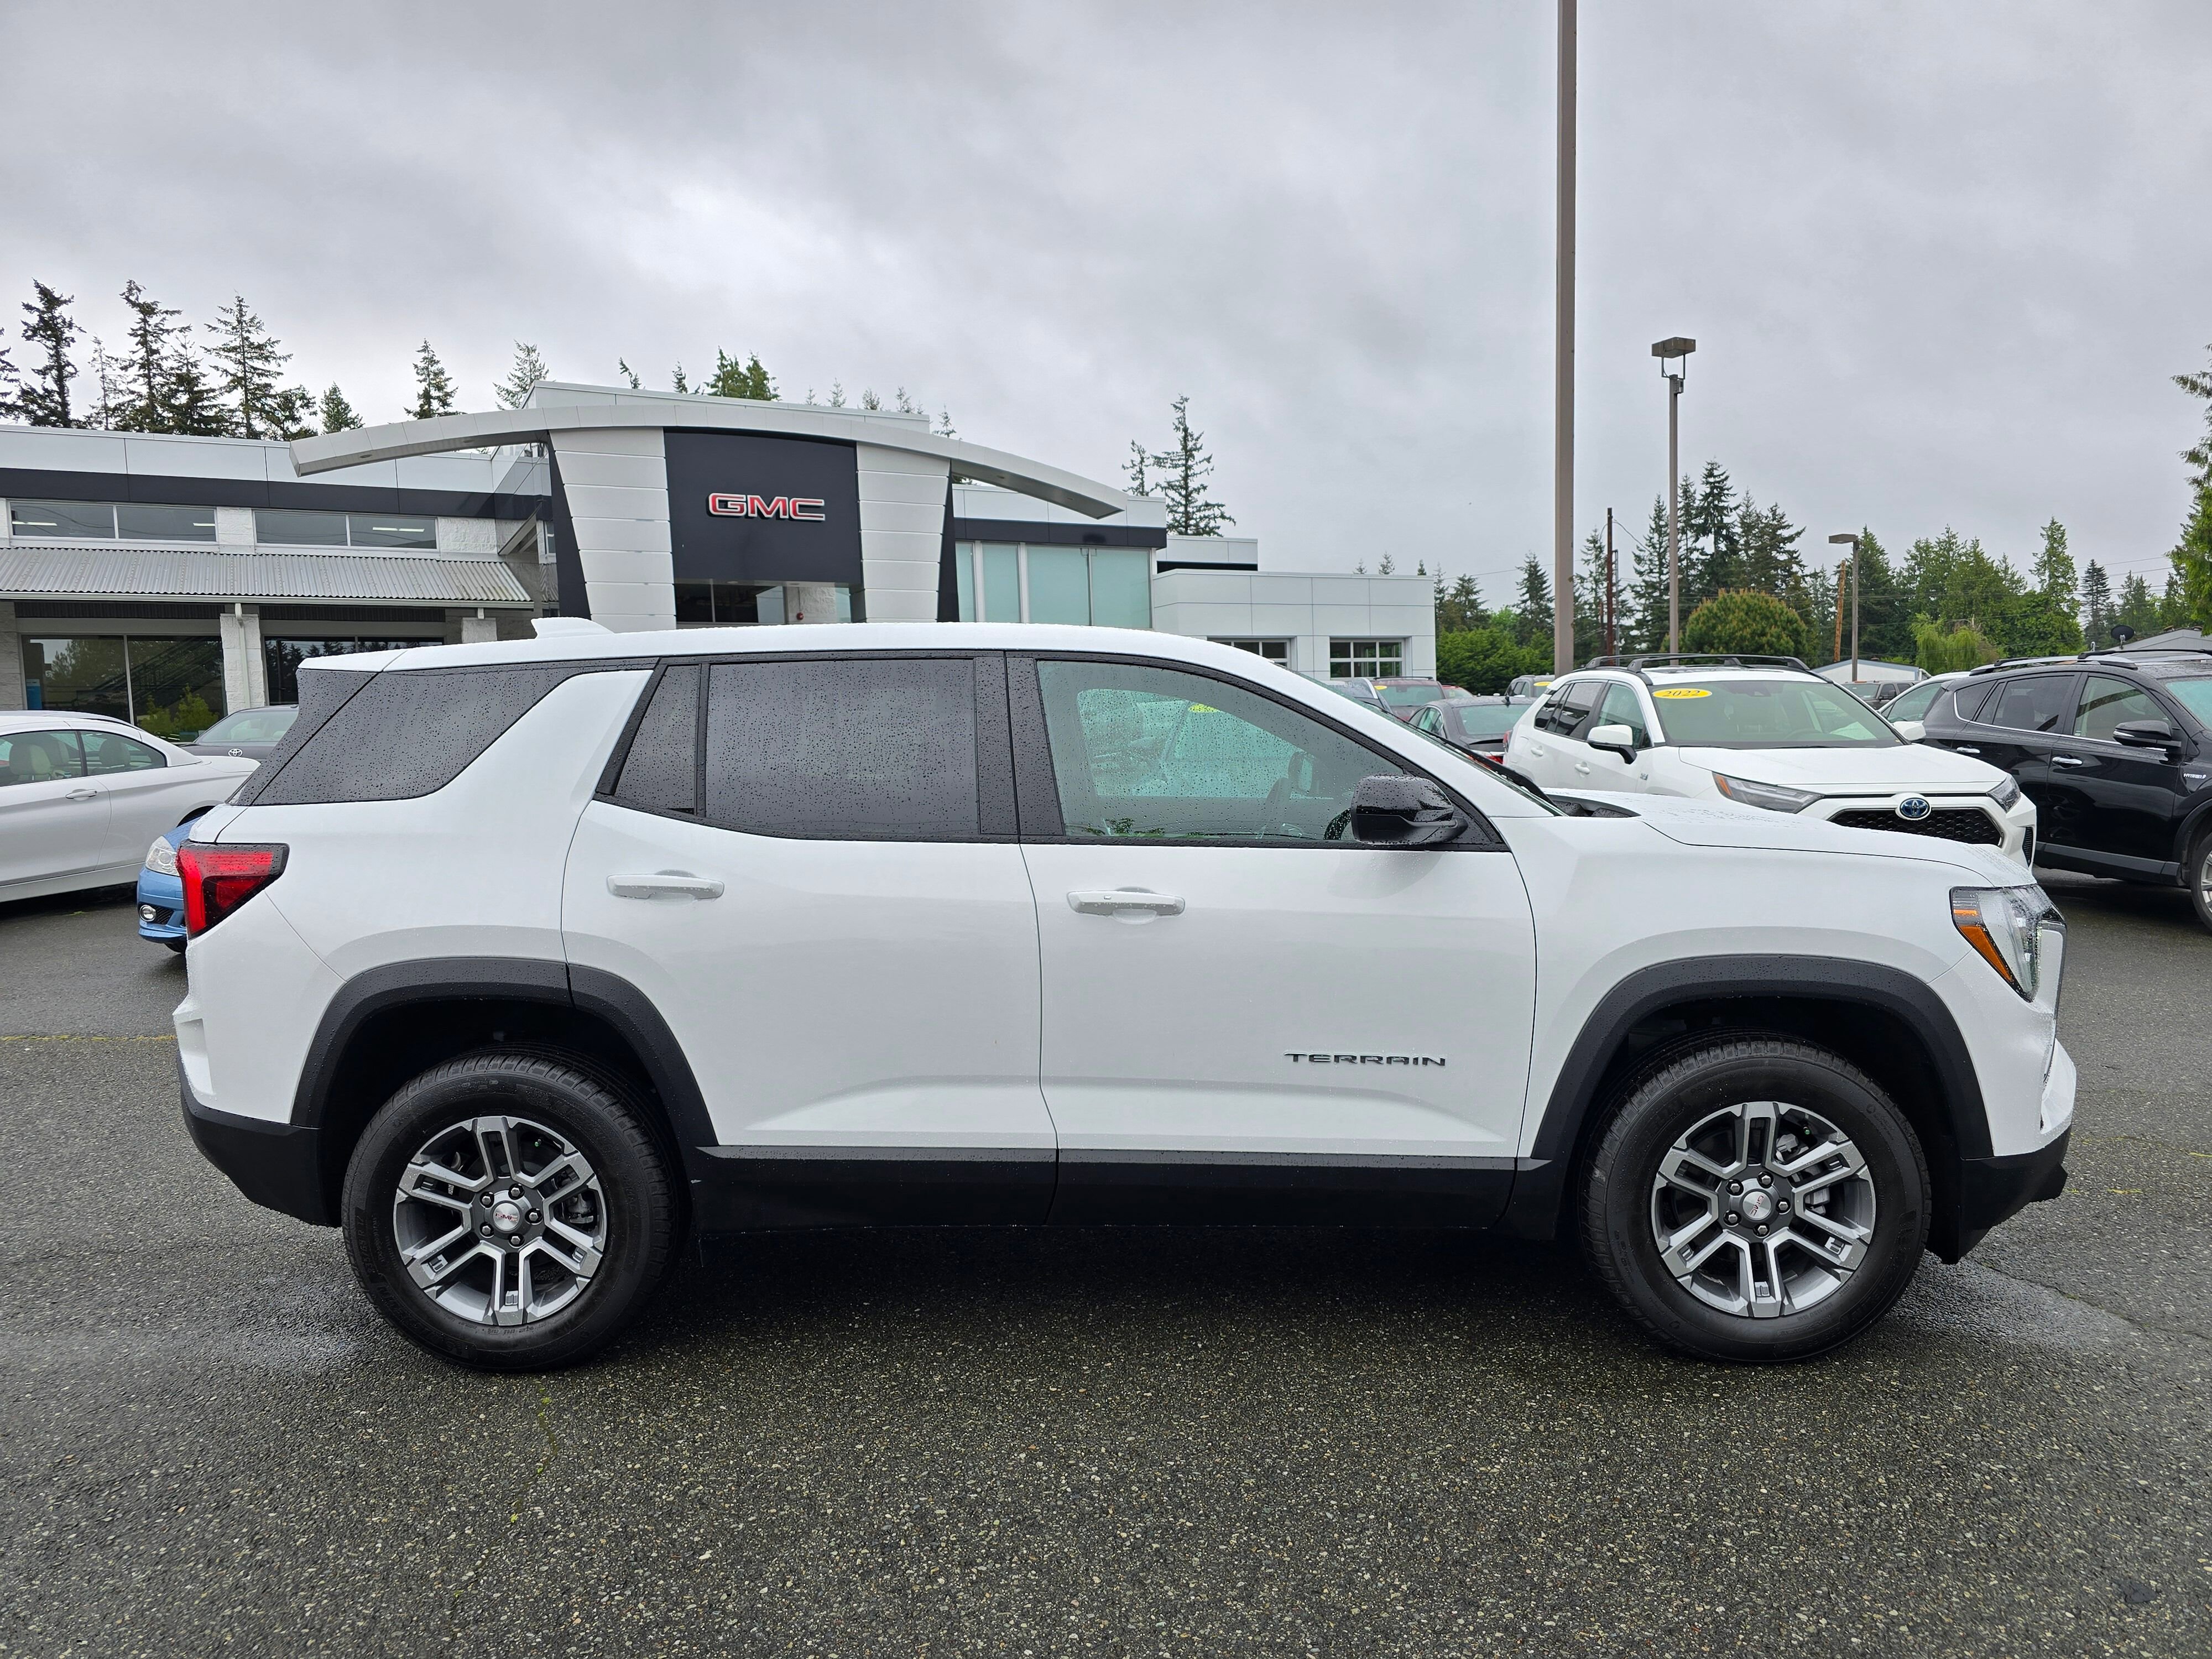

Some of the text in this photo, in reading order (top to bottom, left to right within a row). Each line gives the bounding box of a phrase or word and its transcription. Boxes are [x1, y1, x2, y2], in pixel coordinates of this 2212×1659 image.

[708, 493, 825, 520] GMC
[1283, 1052, 1446, 1066] TERRAIN
[1750, 1195, 1764, 1216] GMC
[495, 1213, 518, 1221] GMC
